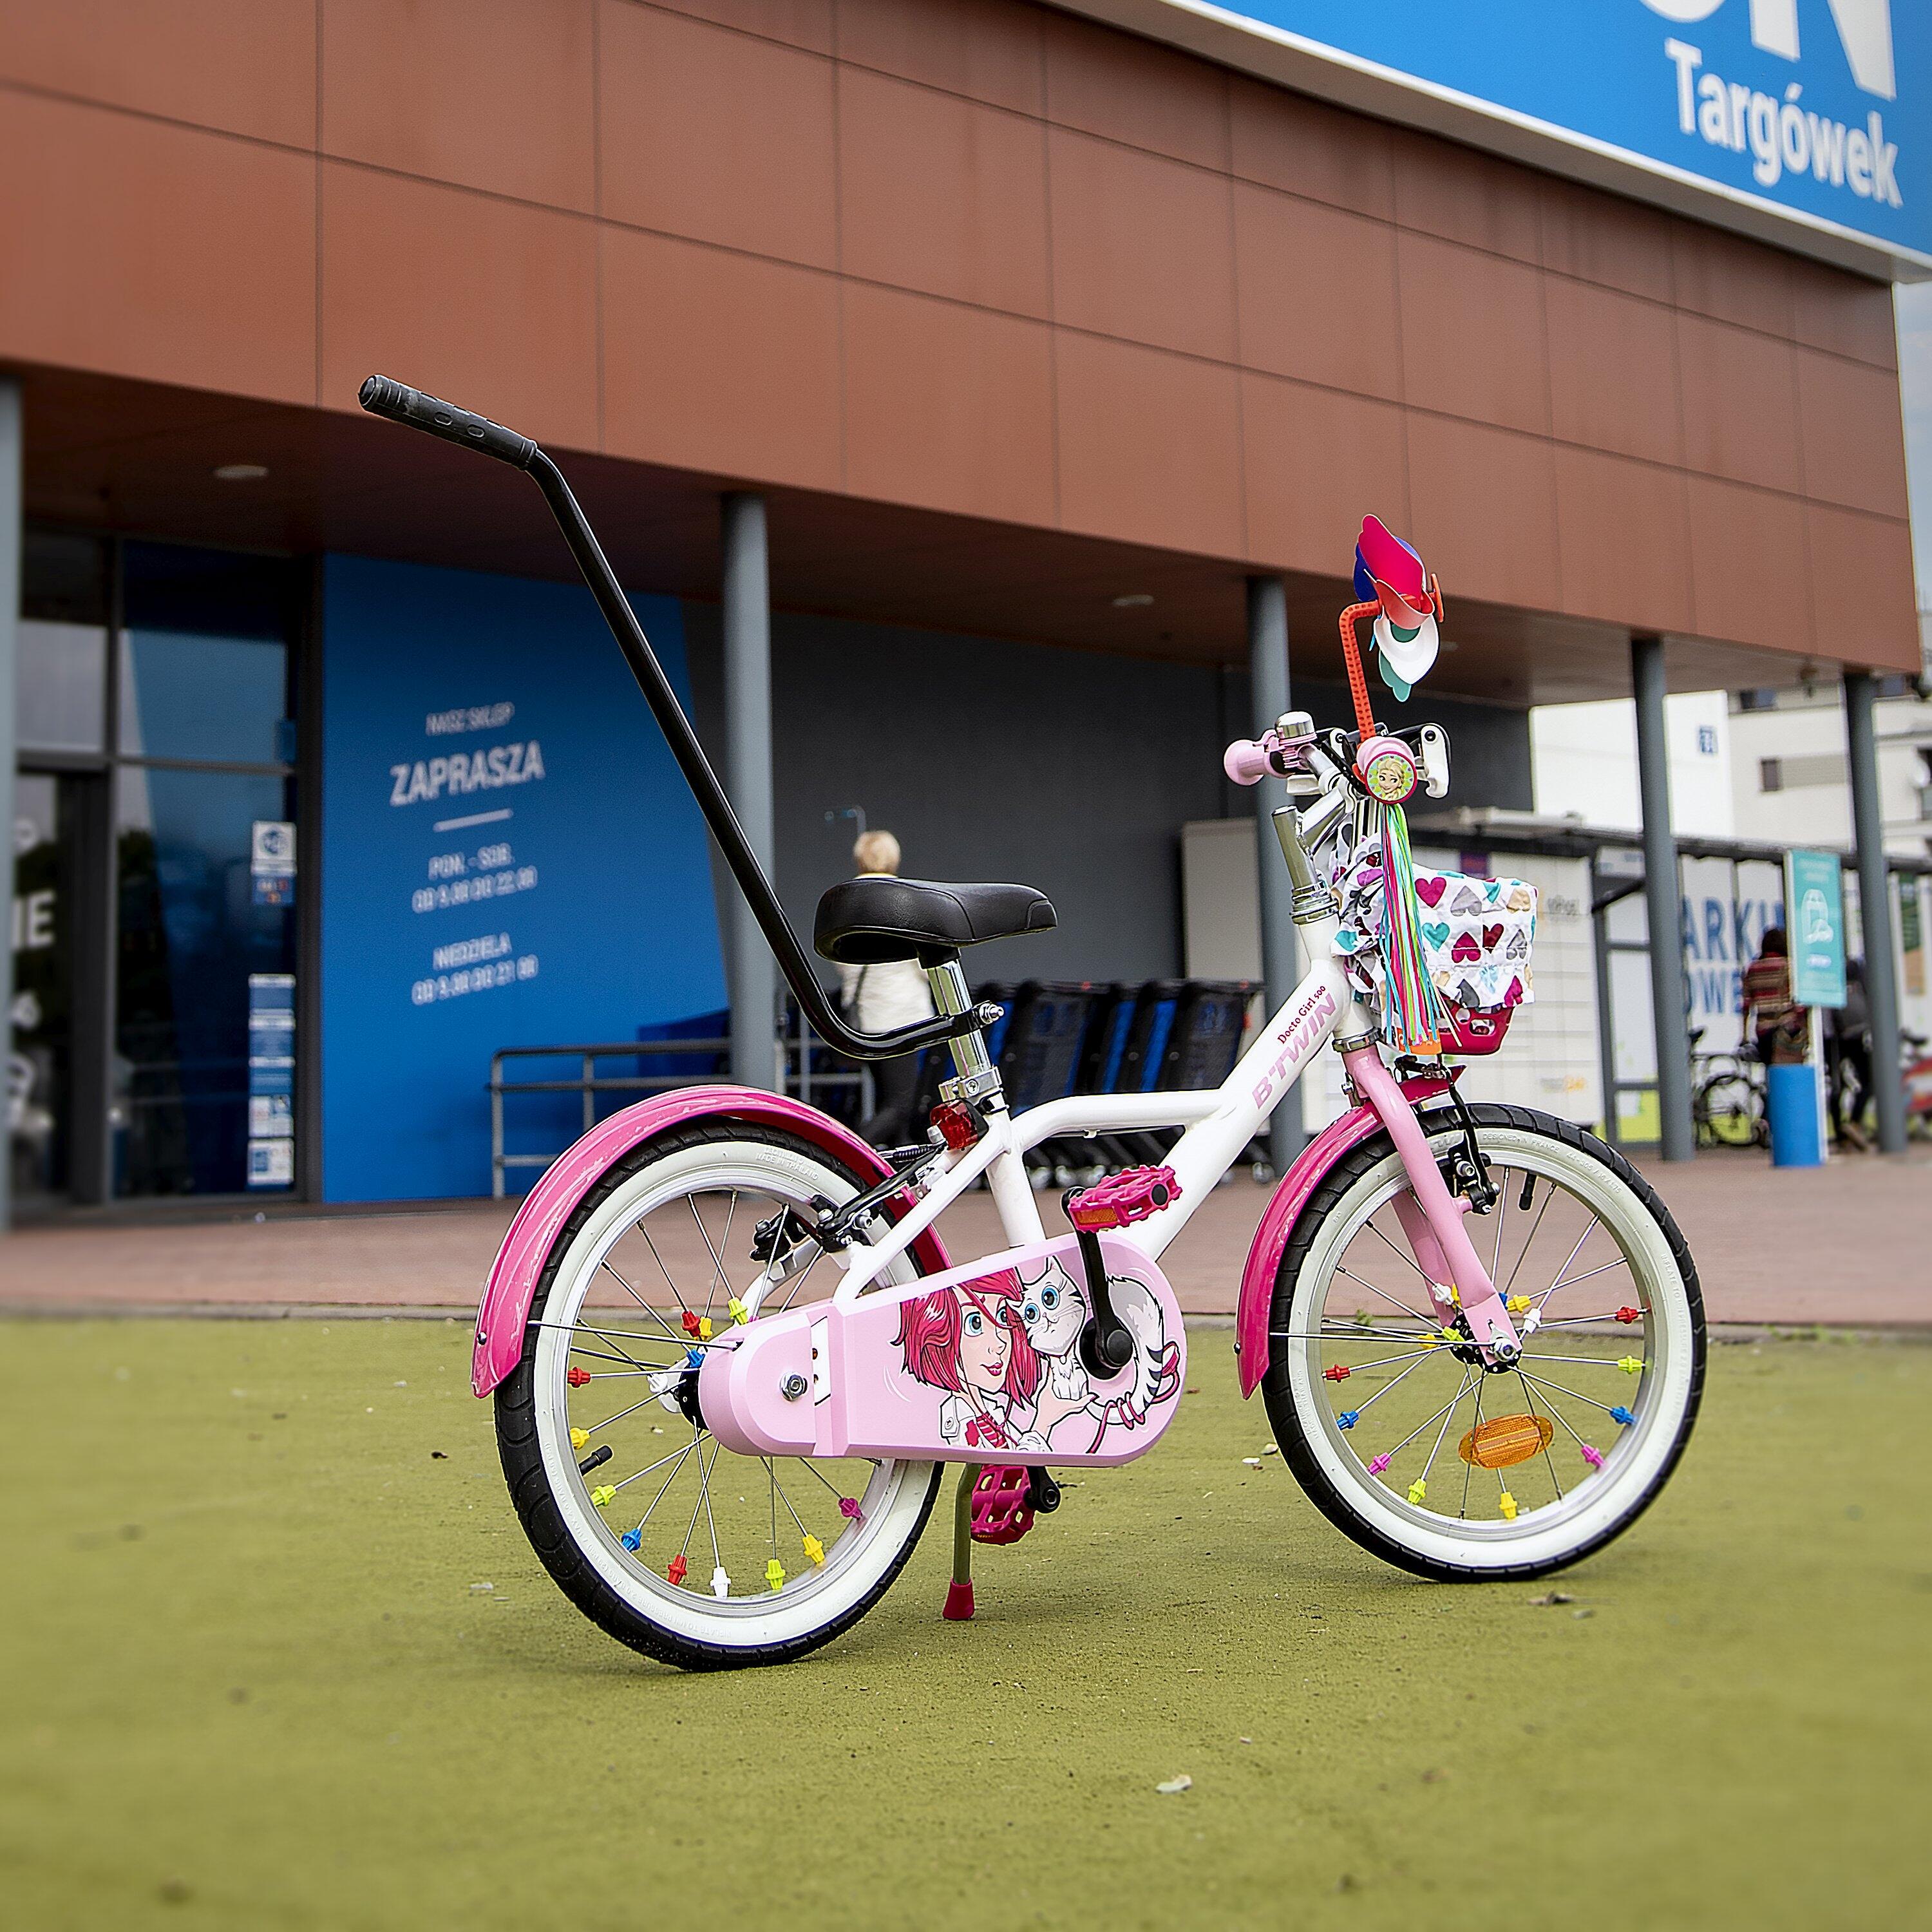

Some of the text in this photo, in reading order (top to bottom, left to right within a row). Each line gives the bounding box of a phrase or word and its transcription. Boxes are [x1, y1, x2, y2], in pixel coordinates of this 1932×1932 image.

[1664, 36, 1904, 209] Targówek
[390, 740, 546, 806] ZAPRASZA
[1277, 1017, 1301, 1045] Docto
[1298, 997, 1316, 1016] Girl
[756, 1153, 776, 1164] MADE
[785, 1160, 819, 1180] THAILAND
[1482, 1132, 1518, 1142] DESIGNED
[1531, 1139, 1560, 1153] FRANCE
